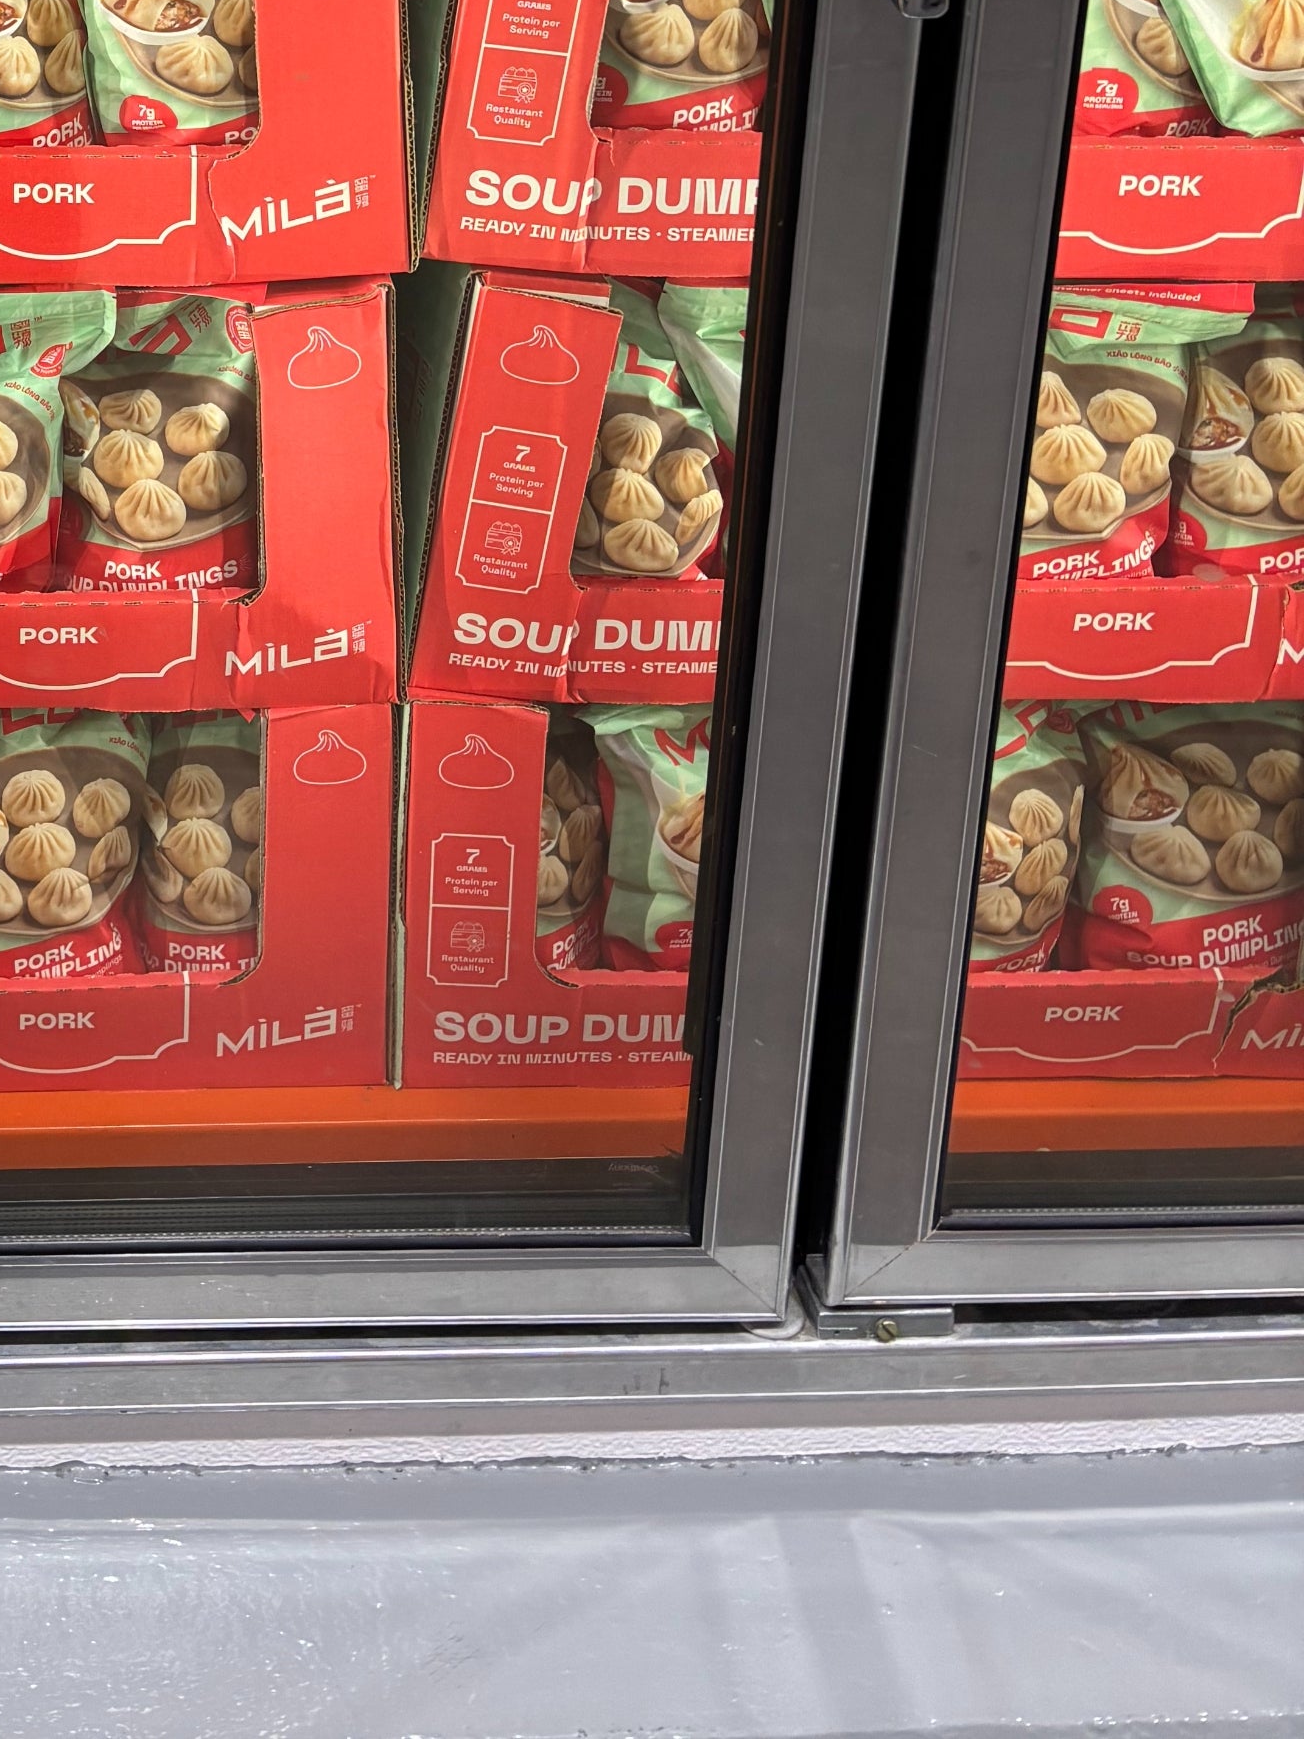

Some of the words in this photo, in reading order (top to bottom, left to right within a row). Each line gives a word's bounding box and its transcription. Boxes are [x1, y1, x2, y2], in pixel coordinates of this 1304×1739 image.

[1096, 80, 1118, 97] 7g
[1083, 96, 1124, 104] PROTEIN
[13, 183, 95, 203] PORK
[465, 170, 602, 216] SOUP
[1118, 175, 1204, 197] PORK
[104, 561, 161, 579] PORK
[1033, 550, 1100, 578] PORK
[1073, 612, 1155, 631] PORK
[19, 627, 98, 645] PORK
[1203, 914, 1263, 947] PORK
[19, 1011, 95, 1030] PORK
[1044, 1006, 1123, 1022] PORK
[433, 1011, 569, 1044] SOUP
